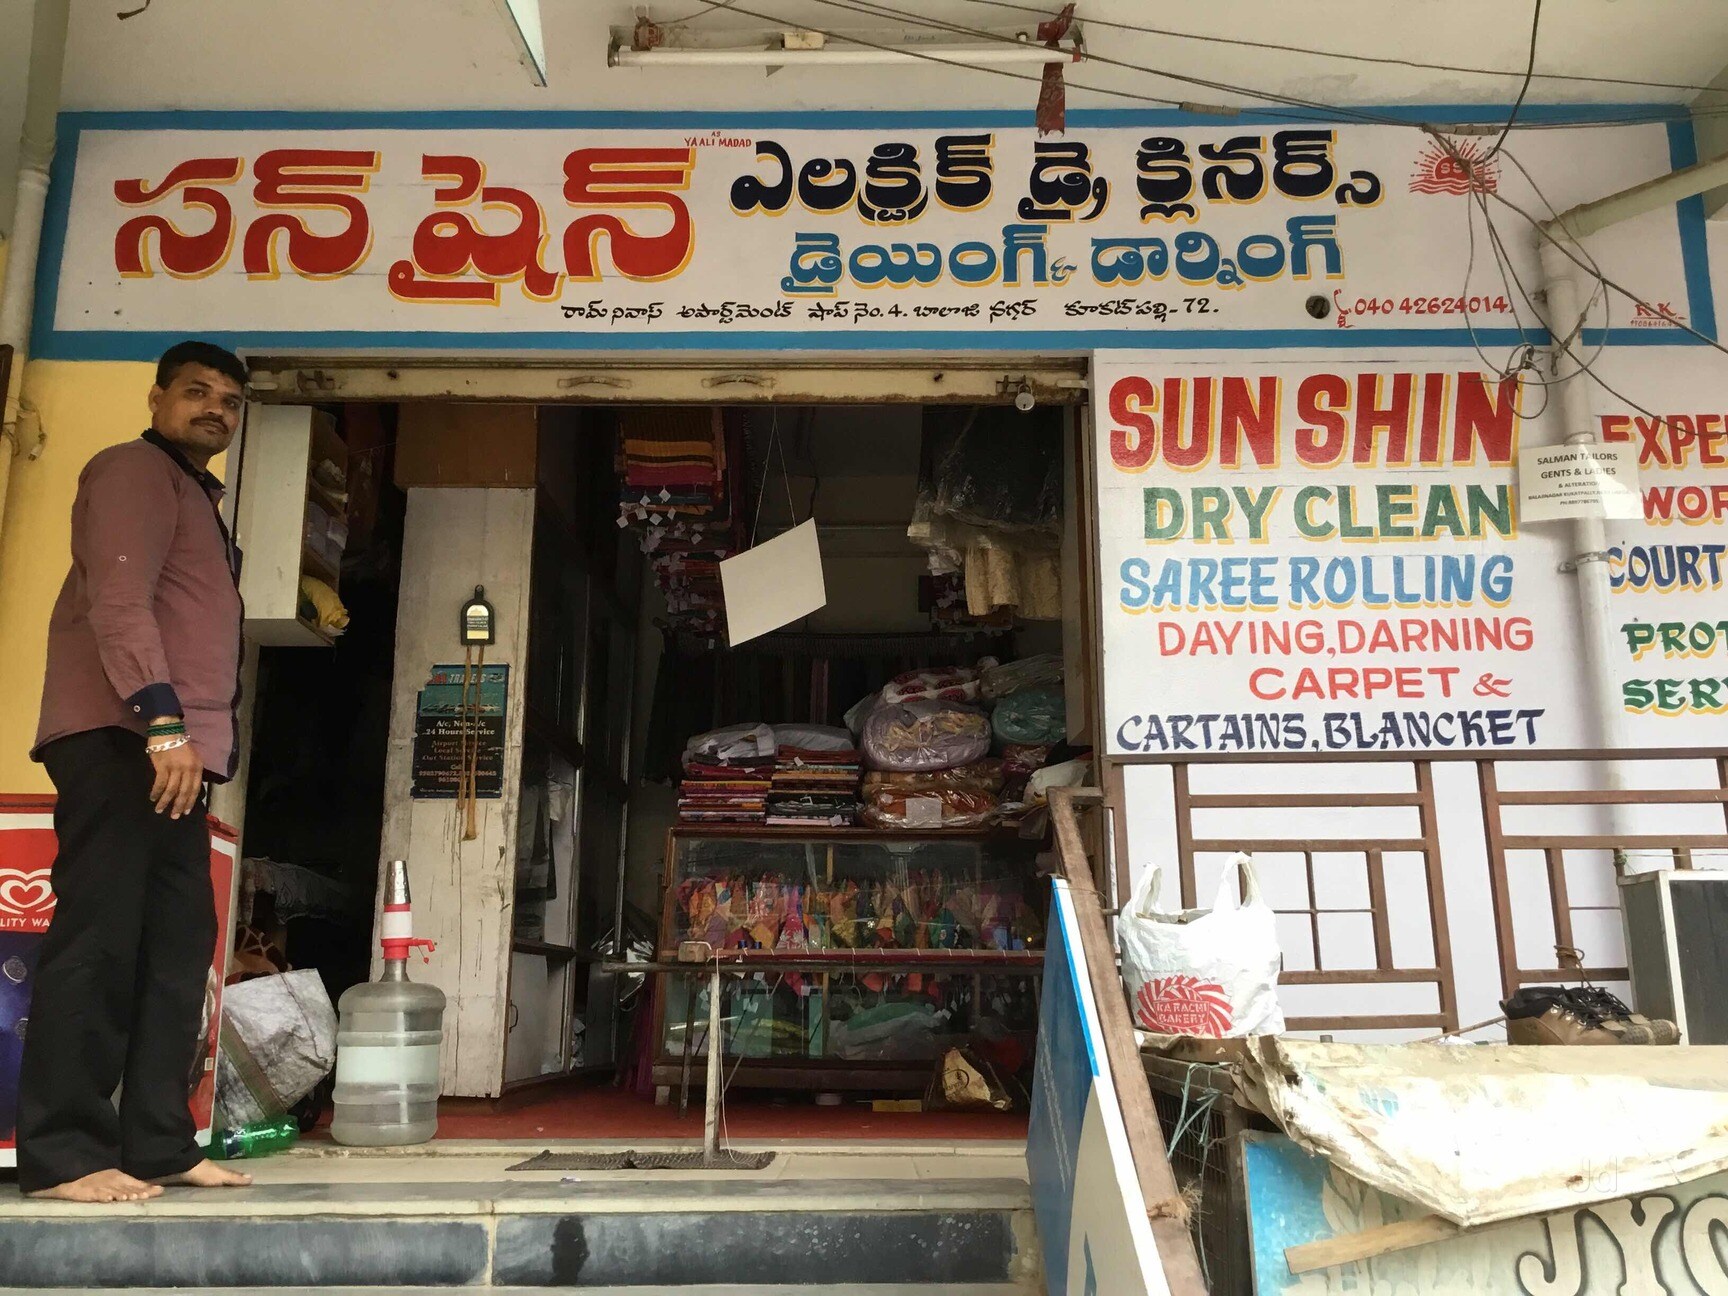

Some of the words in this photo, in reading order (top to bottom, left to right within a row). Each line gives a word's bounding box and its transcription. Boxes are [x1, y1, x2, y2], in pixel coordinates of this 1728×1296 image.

[719, 138, 752, 147] MADAD
[989, 298, 1039, 324] నగర్
[1354, 297, 1394, 315] 040
[1109, 376, 1282, 474] SUN
[1294, 371, 1526, 470] SHIN
[1601, 414, 1728, 470] EXPE
[1537, 453, 1577, 465] SALMAN
[1541, 468, 1571, 479] GENTS
[1574, 468, 1582, 476] &
[1143, 485, 1280, 546] DRY
[1293, 484, 1518, 544] CLEAN
[1119, 555, 1279, 615] SAREE
[1288, 554, 1515, 610] ROLLING
[450, 673, 487, 684] TRAES
[1249, 666, 1460, 701] CARPET
[1472, 672, 1513, 698] &
[1622, 677, 1728, 717] SER
[1156, 1002, 1208, 1013] KARACHI
[1158, 1013, 1206, 1024] BAKERY
